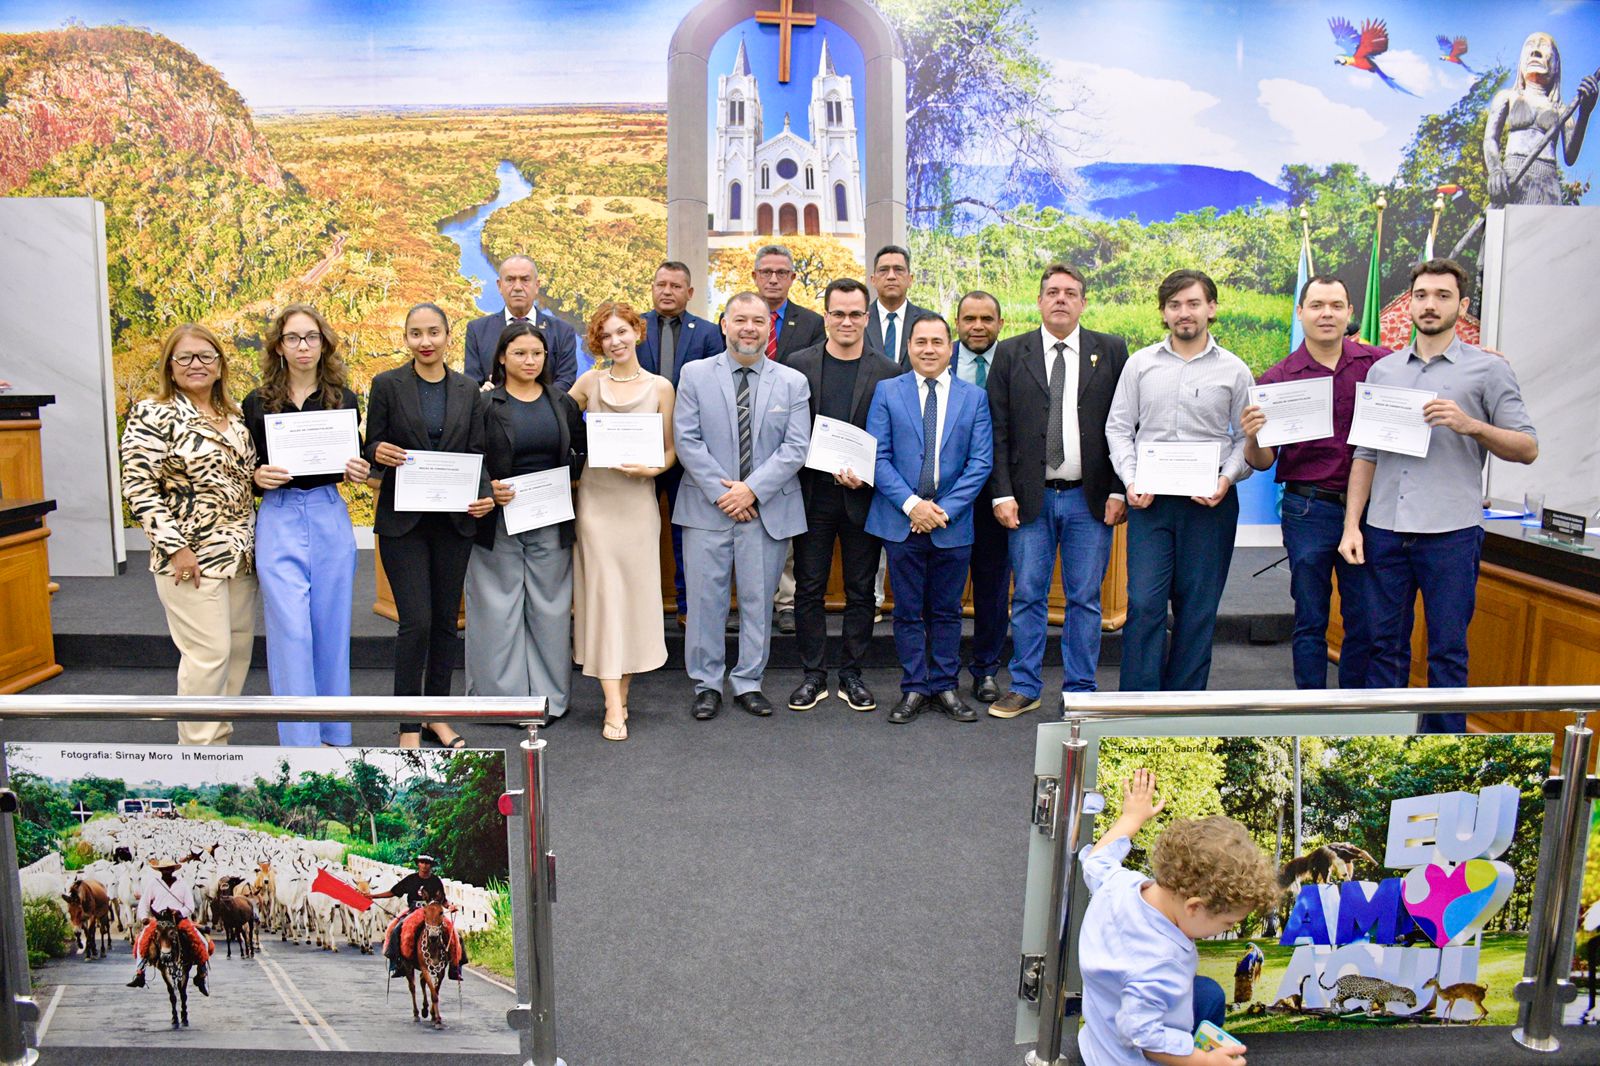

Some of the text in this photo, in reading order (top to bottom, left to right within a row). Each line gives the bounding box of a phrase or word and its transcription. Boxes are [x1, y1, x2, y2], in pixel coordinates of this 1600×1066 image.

[60, 750, 244, 761] Fotografia: Sirnay Moro In Memoriam
[1118, 745, 1169, 755] Fotografia:
[1173, 745, 1212, 753] Gabriela
[1384, 785, 1520, 869] EU
